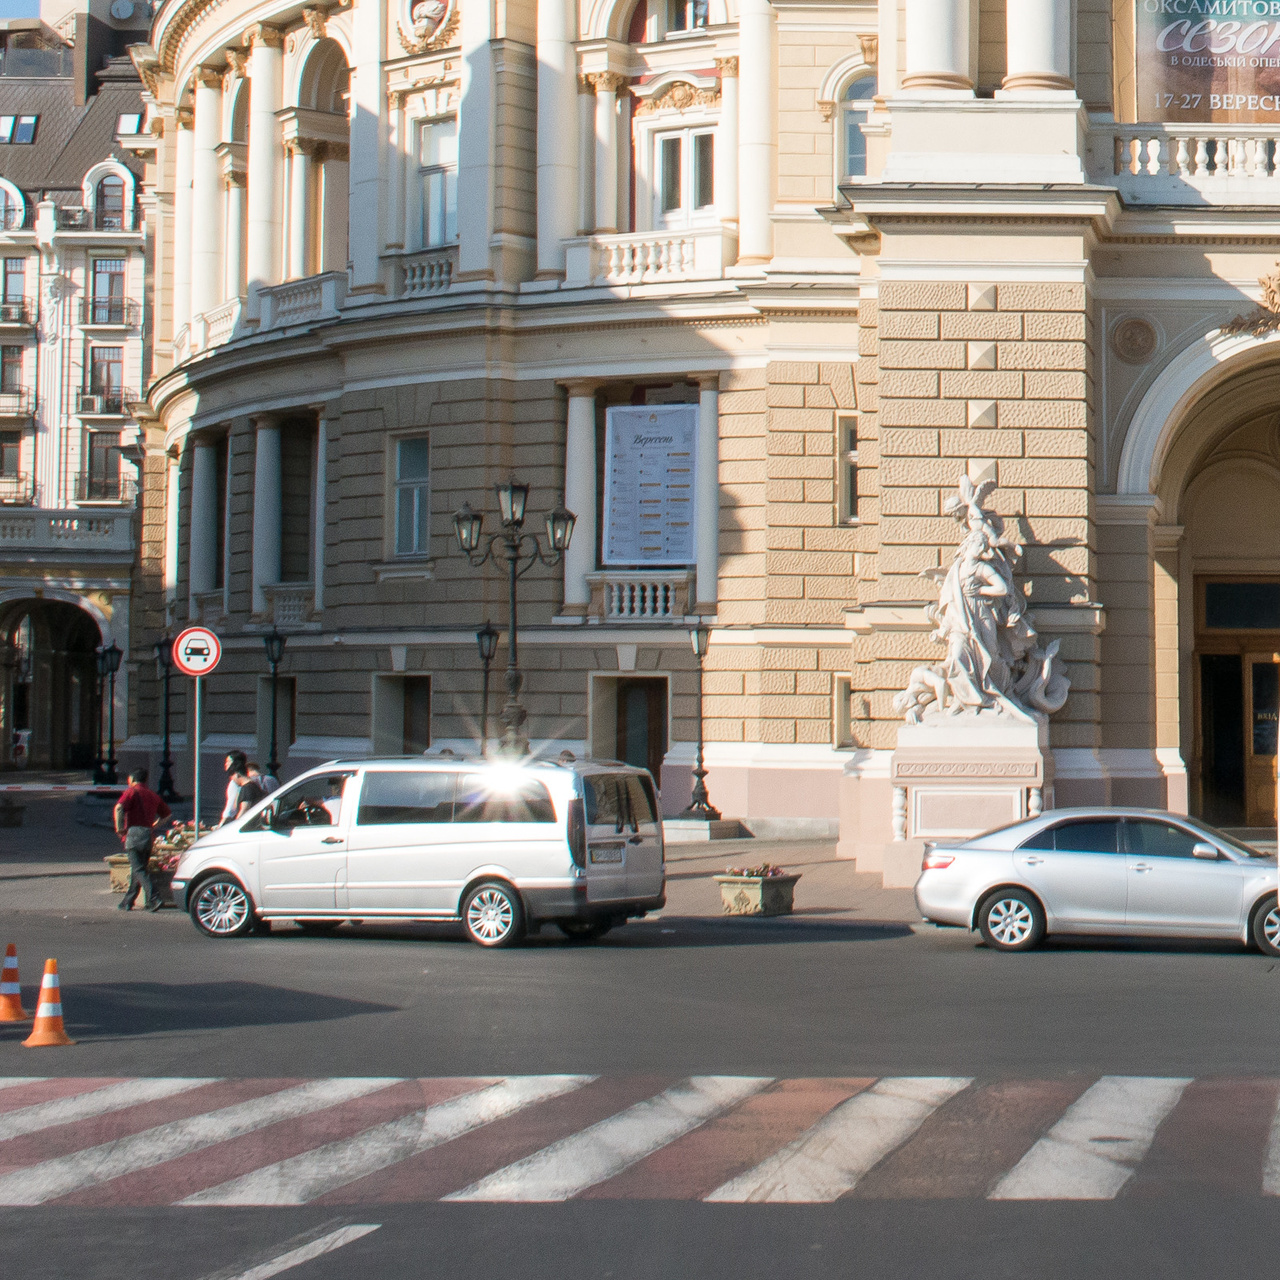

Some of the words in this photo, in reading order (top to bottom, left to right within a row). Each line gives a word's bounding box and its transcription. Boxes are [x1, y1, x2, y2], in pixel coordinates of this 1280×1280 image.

[1170, 56, 1179, 66] В
[1181, 56, 1246, 67] ОДЕСЬКІЙ
[1154, 92, 1202, 109] 17-27
